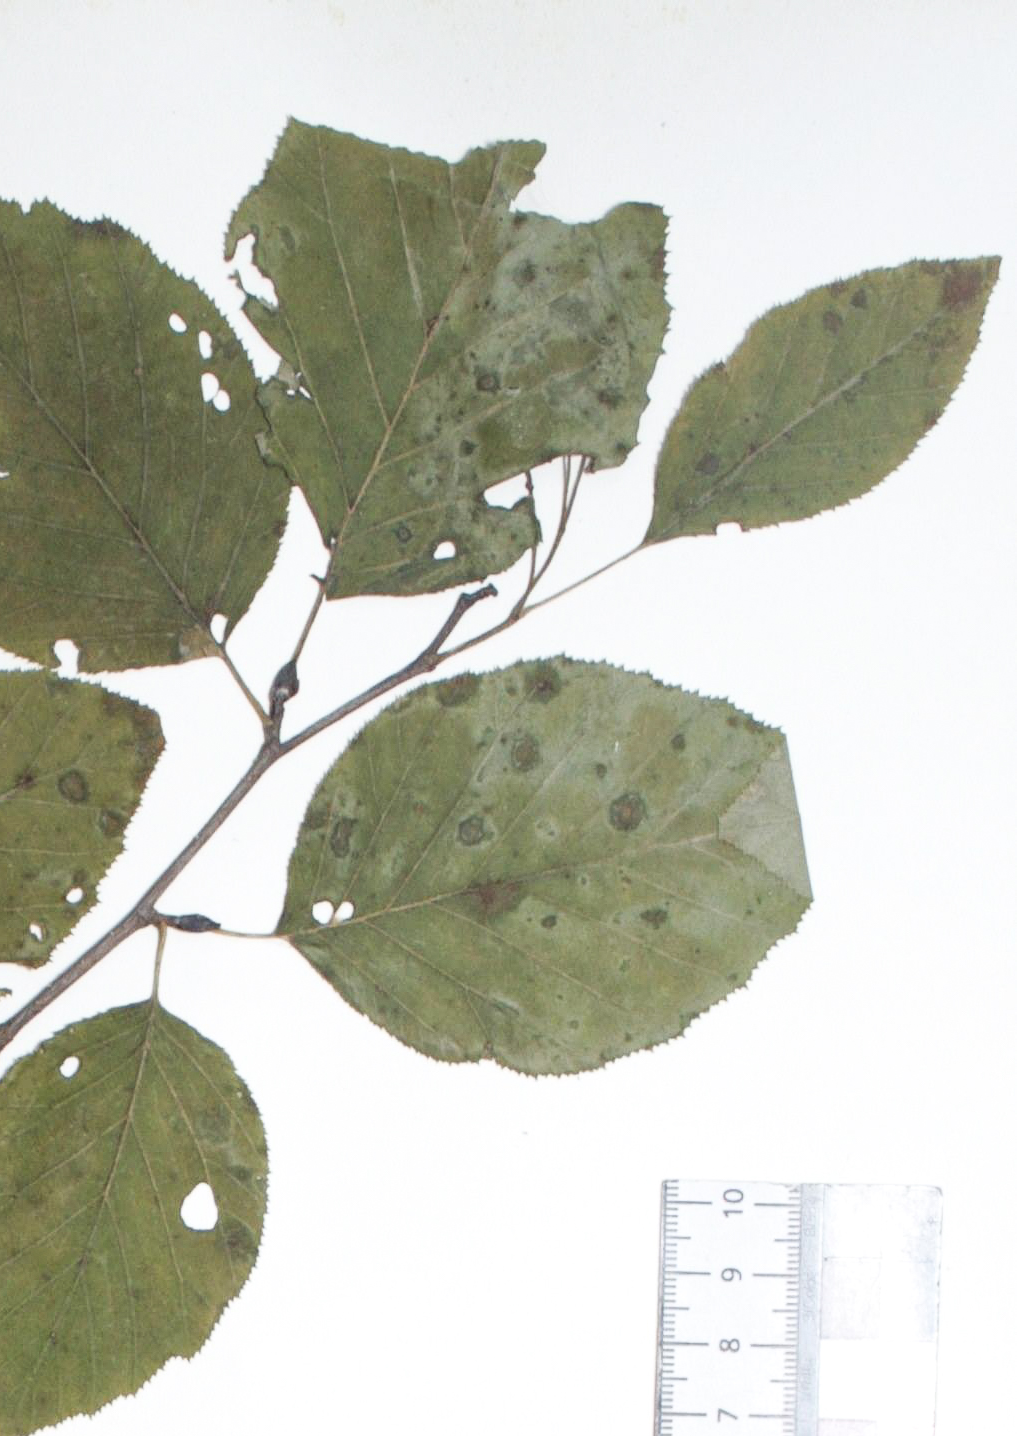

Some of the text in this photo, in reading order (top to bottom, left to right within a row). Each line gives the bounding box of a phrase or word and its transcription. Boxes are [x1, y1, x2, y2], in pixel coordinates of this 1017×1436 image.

[722, 1188, 744, 1218] 10
[721, 1267, 742, 1282] 9
[719, 1338, 740, 1353] 8
[717, 1408, 739, 1423] 7
